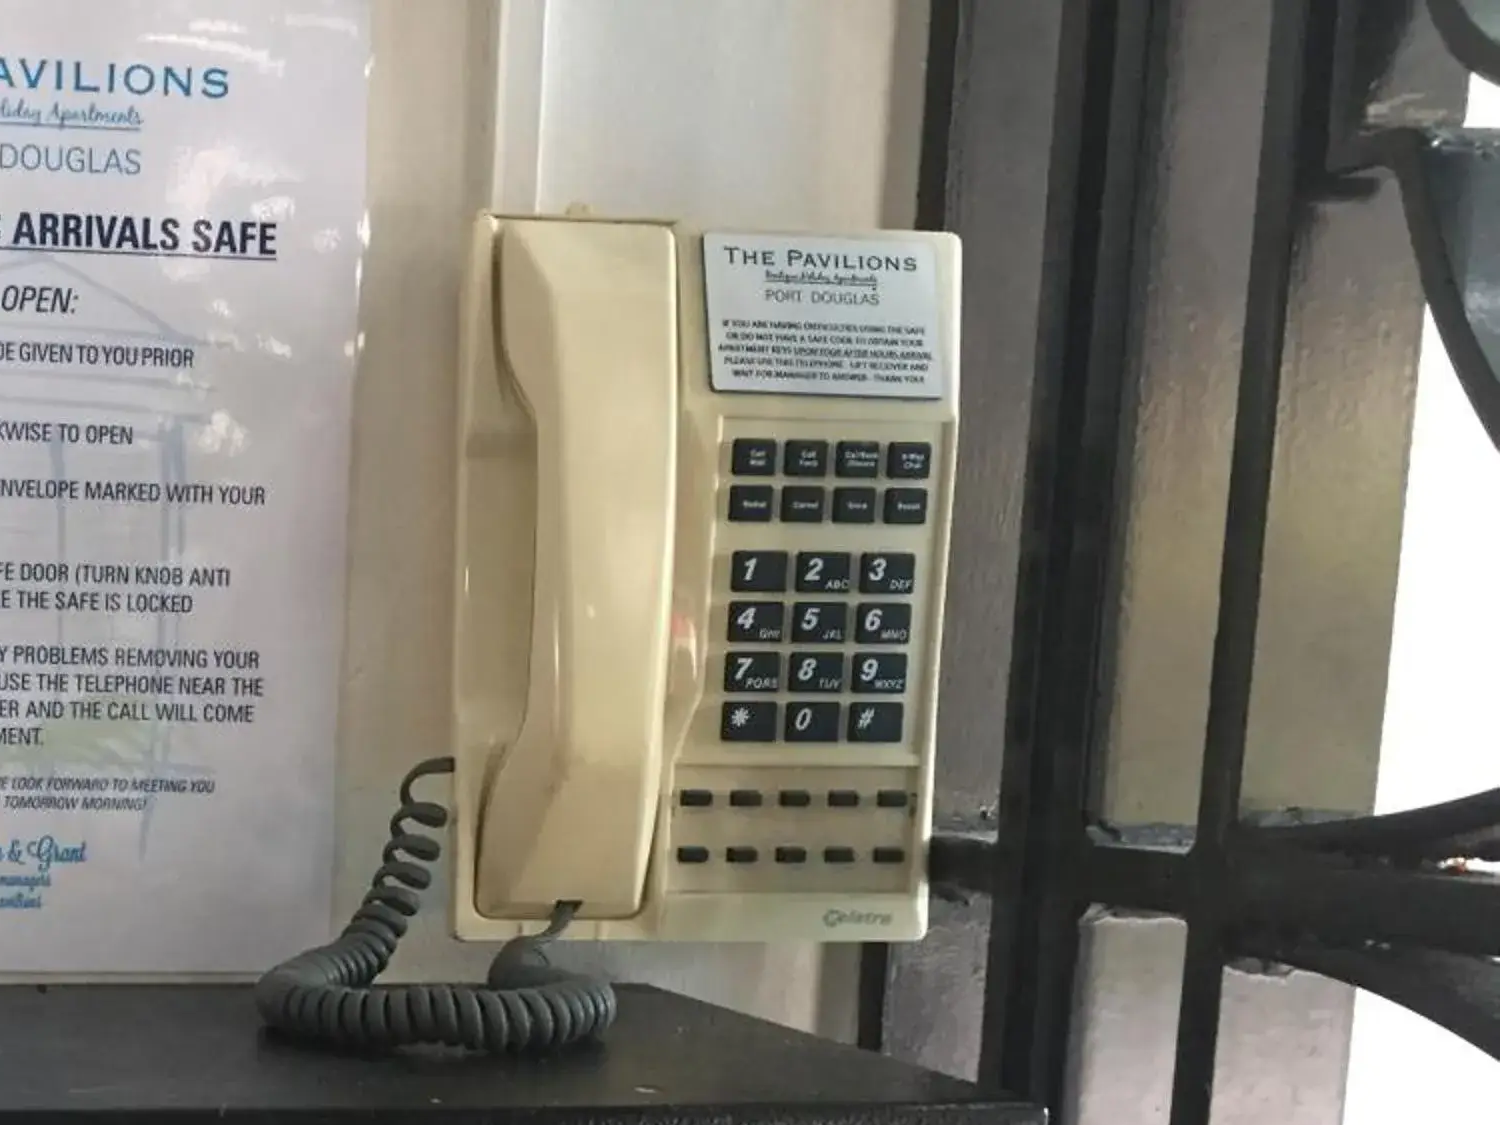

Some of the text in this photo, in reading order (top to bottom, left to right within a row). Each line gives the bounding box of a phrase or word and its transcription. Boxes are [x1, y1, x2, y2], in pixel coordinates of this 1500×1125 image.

[49, 101, 144, 129] Apartments
[11, 211, 181, 250] ARRIVALS
[192, 219, 278, 255] SAFE
[724, 246, 918, 272] THE PAVILIONS
[1, 285, 79, 314] OPEN:
[812, 291, 880, 306] DOUGLAS
[20, 343, 73, 363] GIVEN
[76, 345, 98, 365] TO
[102, 347, 139, 366] YOU
[142, 348, 194, 367] PRIOR
[58, 423, 79, 443] TO
[86, 424, 133, 444] OPEN
[85, 481, 161, 501] MARKED
[166, 483, 213, 503] WITH
[219, 485, 265, 505] YOUR
[20, 563, 69, 582] DOOR
[75, 564, 129, 585] (TURN
[136, 566, 183, 585] KNOB
[189, 568, 230, 587] ANTI
[743, 557, 757, 581] 1
[804, 557, 824, 581] 2
[868, 558, 887, 581] 3
[825, 580, 849, 590] ABC
[889, 580, 912, 590] DEF
[17, 590, 49, 609] THE
[55, 592, 99, 611] SAFE
[105, 593, 120, 611] IS
[127, 594, 193, 613] LOCKED
[737, 607, 756, 629] 4
[801, 608, 820, 631] 5
[865, 608, 883, 631] 6
[13, 645, 108, 666] PROBLEMS
[115, 648, 208, 668] REMOVING
[214, 650, 260, 669] YOUR
[735, 657, 753, 680] 7
[798, 657, 817, 681] 8
[860, 658, 879, 681] 9
[36, 673, 68, 692] THE
[74, 674, 174, 694] TELEPHONE
[179, 676, 225, 696] NEAR
[232, 677, 264, 697] THE
[25, 701, 64, 719] AND
[70, 702, 101, 720] THE
[107, 703, 149, 721] CALL
[155, 704, 197, 721] WILL
[203, 705, 255, 723] COME
[795, 708, 812, 731] 0
[11, 777, 42, 791] LOOK
[47, 777, 109, 792] FORWARD
[113, 779, 128, 792] TO
[131, 779, 187, 793] MEETING
[190, 781, 216, 795] YOU
[3, 796, 79, 811] TOMORROW
[81, 797, 148, 811] MORNING!
[7, 839, 25, 865] &
[27, 835, 87, 871] Grant
